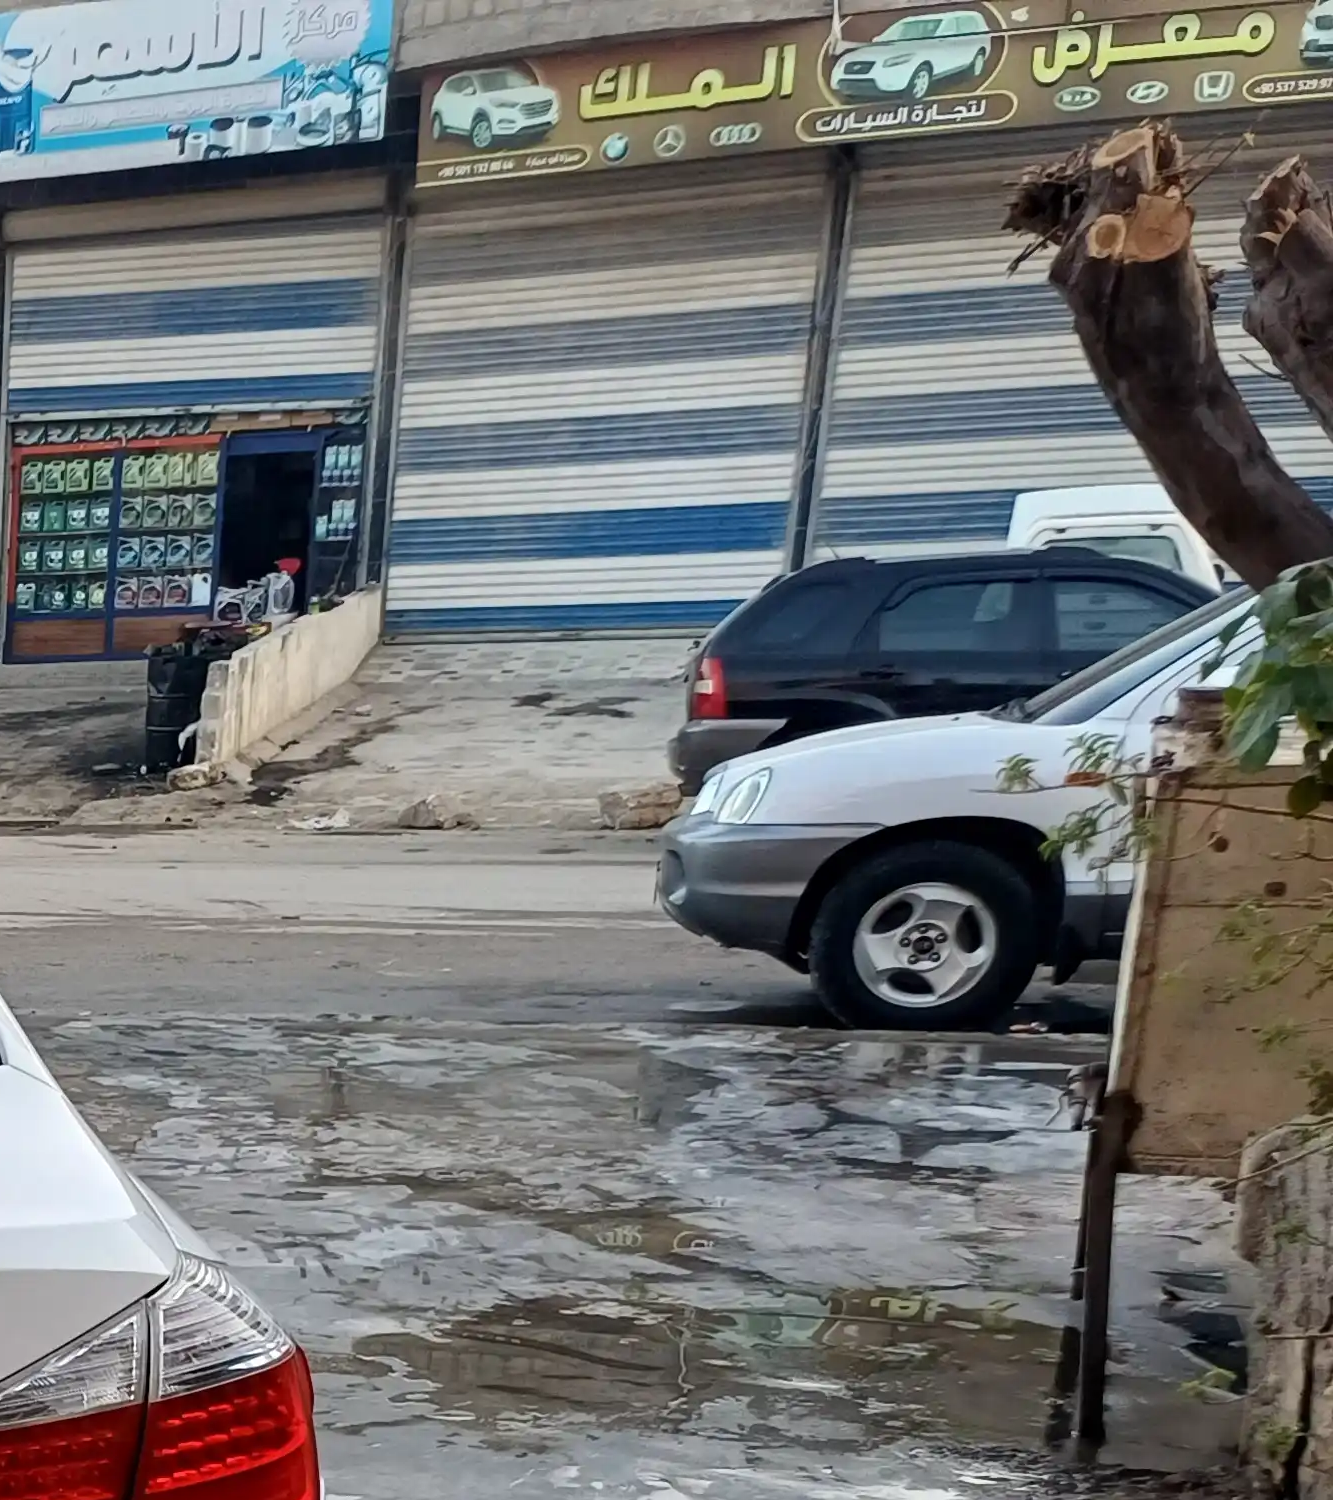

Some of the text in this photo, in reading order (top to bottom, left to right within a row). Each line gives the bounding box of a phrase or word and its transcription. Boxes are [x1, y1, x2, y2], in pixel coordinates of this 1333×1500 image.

[287, 0, 358, 45] مركز
[579, 9, 1276, 120] معرض الملك
[815, 99, 987, 134] لتجارة السيارات
